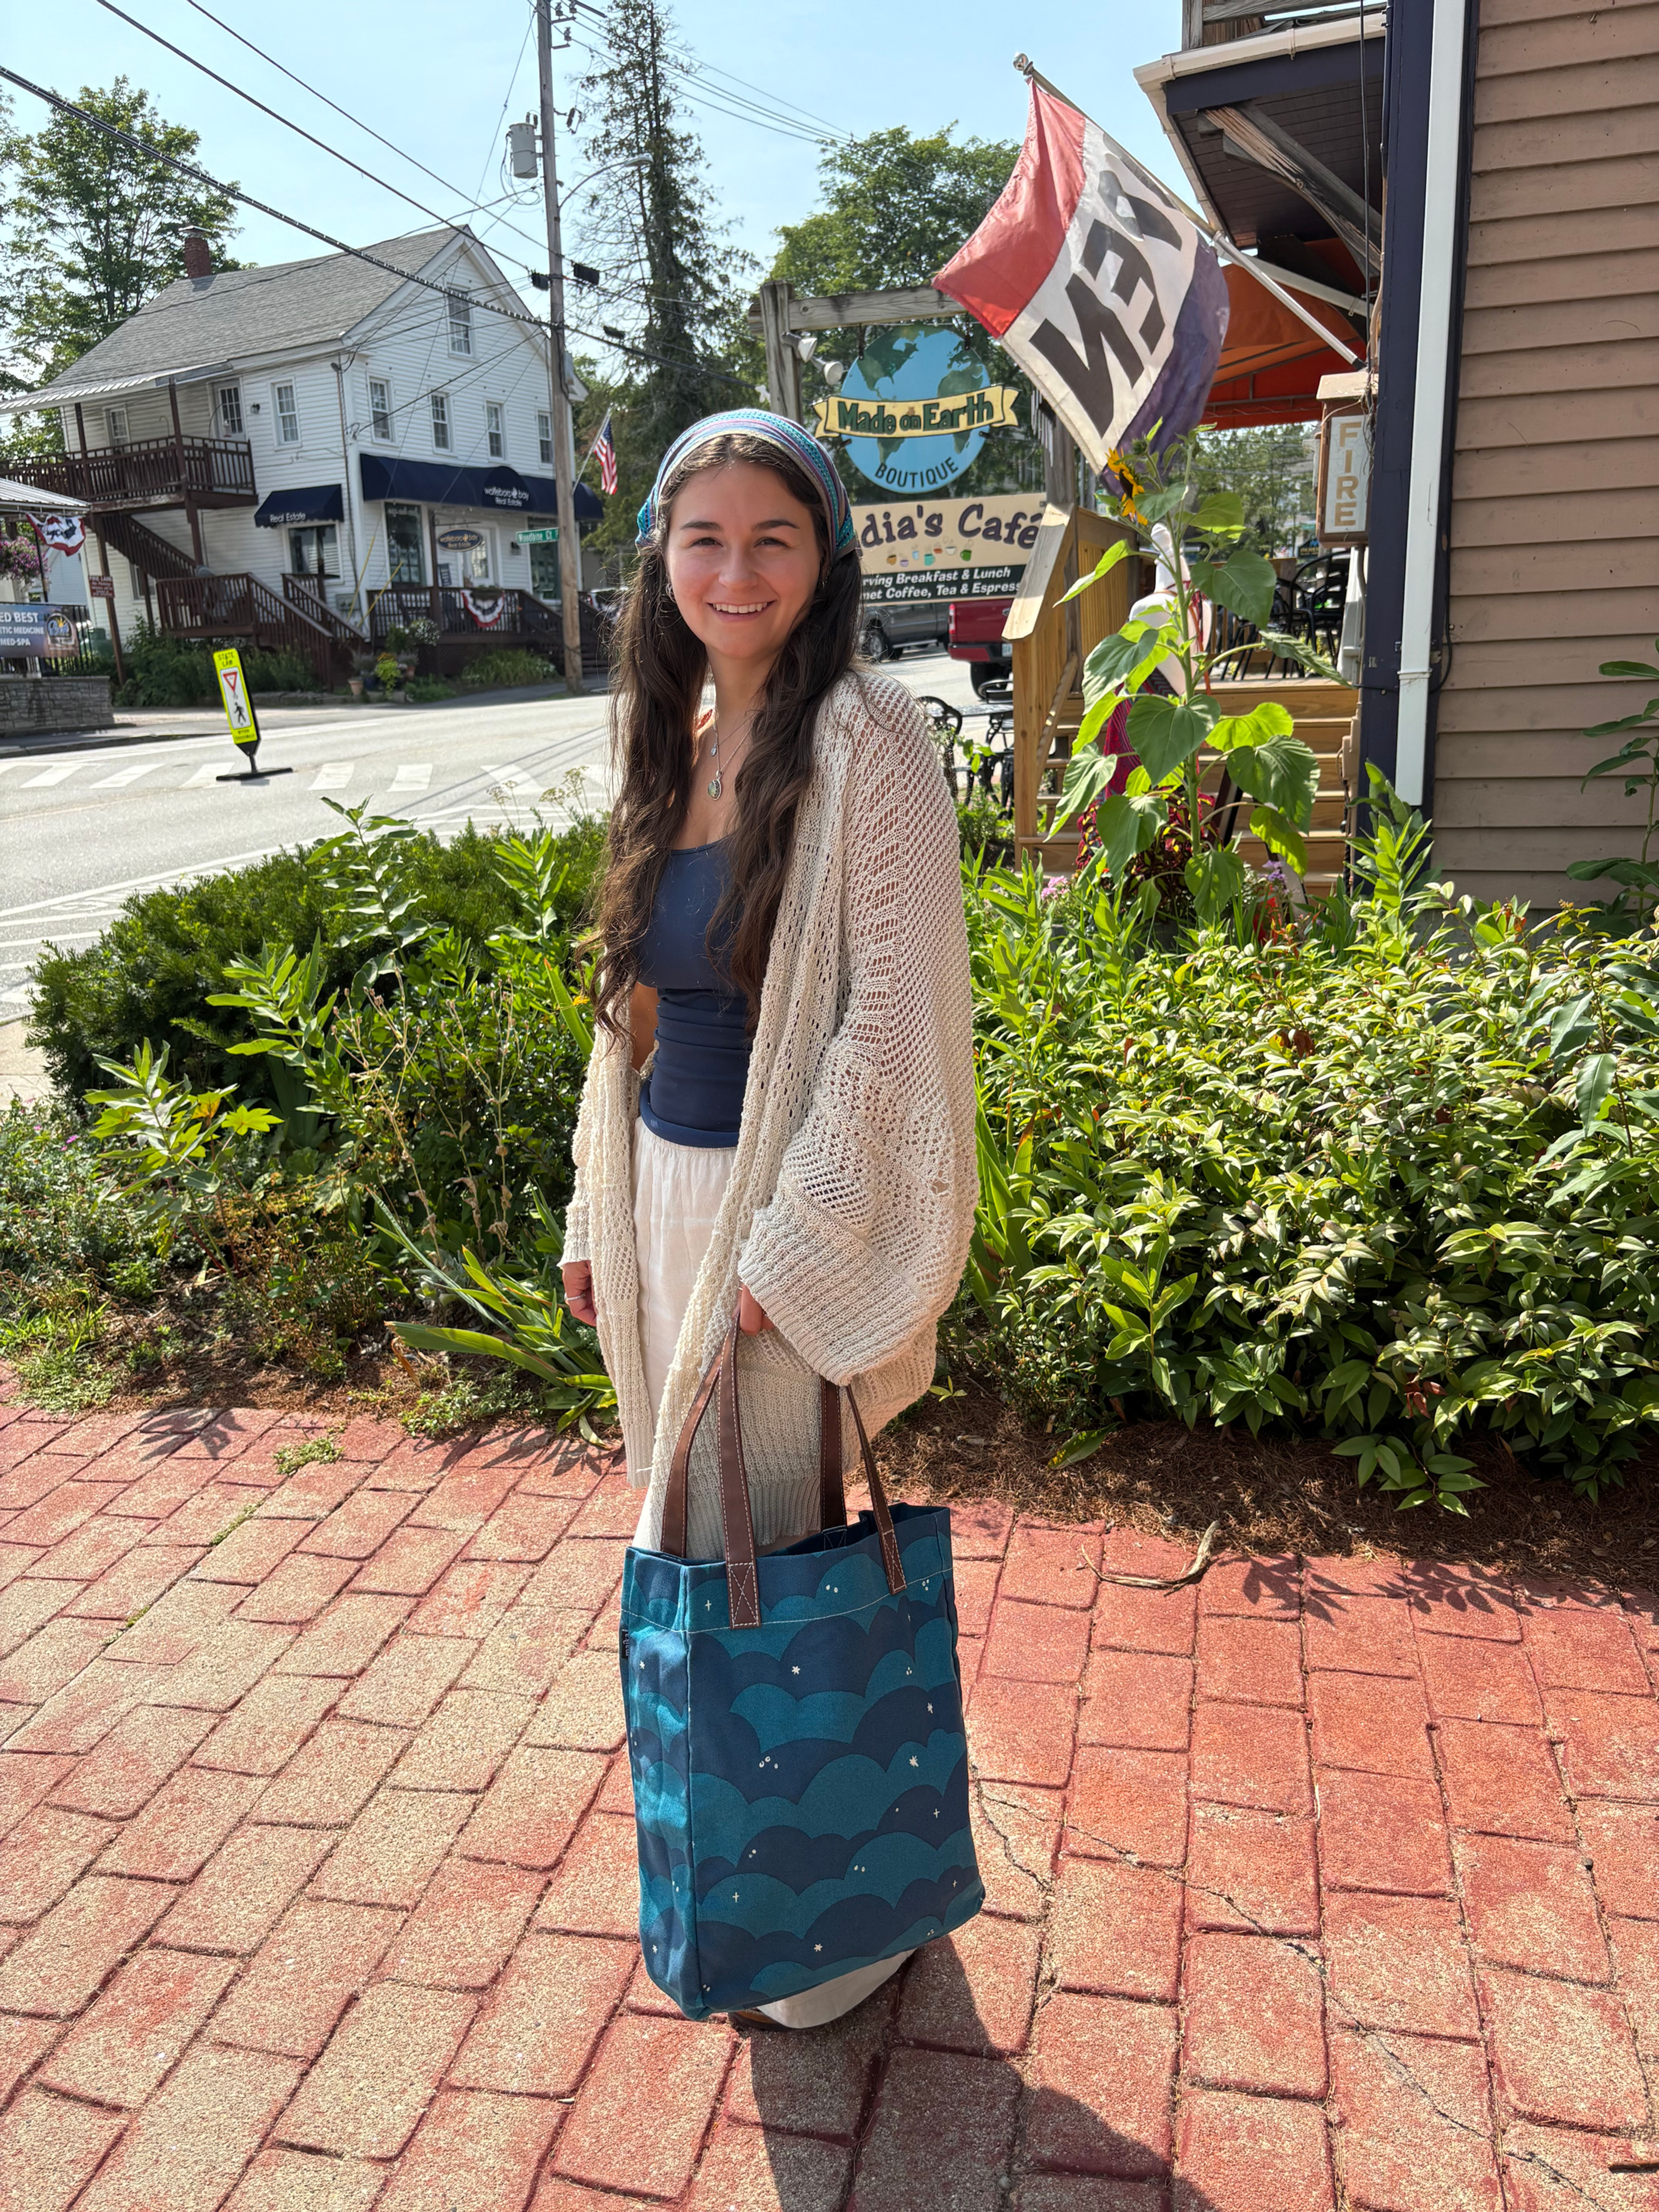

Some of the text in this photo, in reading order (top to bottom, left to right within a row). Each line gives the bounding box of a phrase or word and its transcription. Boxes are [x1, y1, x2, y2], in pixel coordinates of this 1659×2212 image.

[838, 392, 994, 435] Made on Earth
[875, 457, 959, 488] BOUTIQUE
[1334, 421, 1362, 527] FIRE
[495, 496, 522, 507] Real Estate
[270, 512, 306, 523] Real Estate
[860, 503, 1042, 550] dia's Café
[862, 566, 1011, 588] rving Breakfast & Lunch
[860, 581, 1021, 600] met Coffee, Tea & Espress
[0, 612, 38, 623] ED BEST
[0, 626, 45, 635] TIC MEDICINE
[218, 651, 234, 661] STATE
